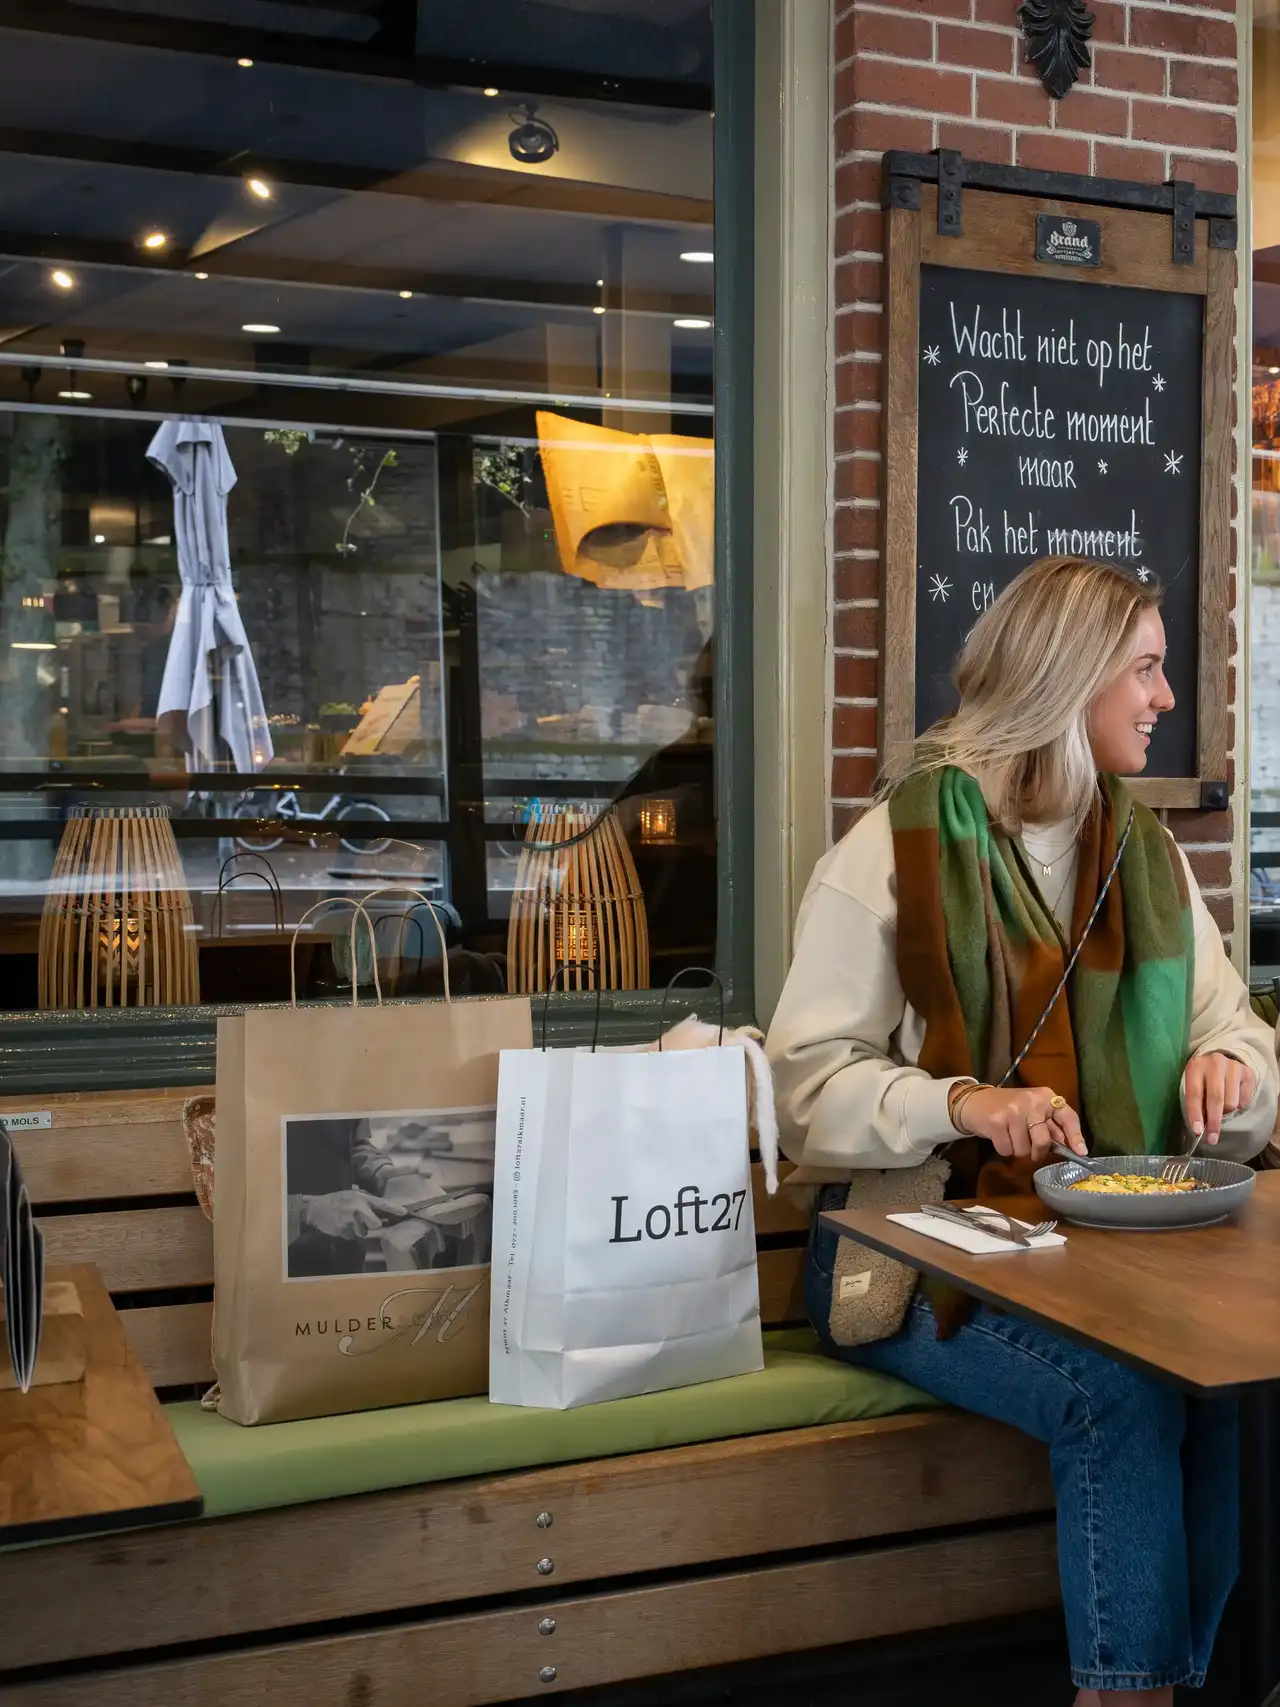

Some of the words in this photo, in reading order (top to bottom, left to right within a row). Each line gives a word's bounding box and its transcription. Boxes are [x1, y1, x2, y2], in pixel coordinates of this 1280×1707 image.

[1050, 230, 1089, 248] Brand
[950, 301, 1027, 361] Wacht
[1037, 319, 1078, 366] niet
[1086, 338, 1113, 388] op
[1118, 321, 1153, 371] het
[949, 370, 1056, 440] Perfecte
[1067, 396, 1156, 445] moment
[1018, 455, 1077, 488] maar
[949, 495, 993, 554] Pak
[1003, 509, 1039, 555] het
[1047, 508, 1144, 557] moment
[971, 580, 996, 612] en
[11, 1117, 39, 1126] MOLS
[609, 1185, 747, 1243] Loft27
[503, 1275, 512, 1314] Alkmaar
[295, 1316, 396, 1336] MULDER
